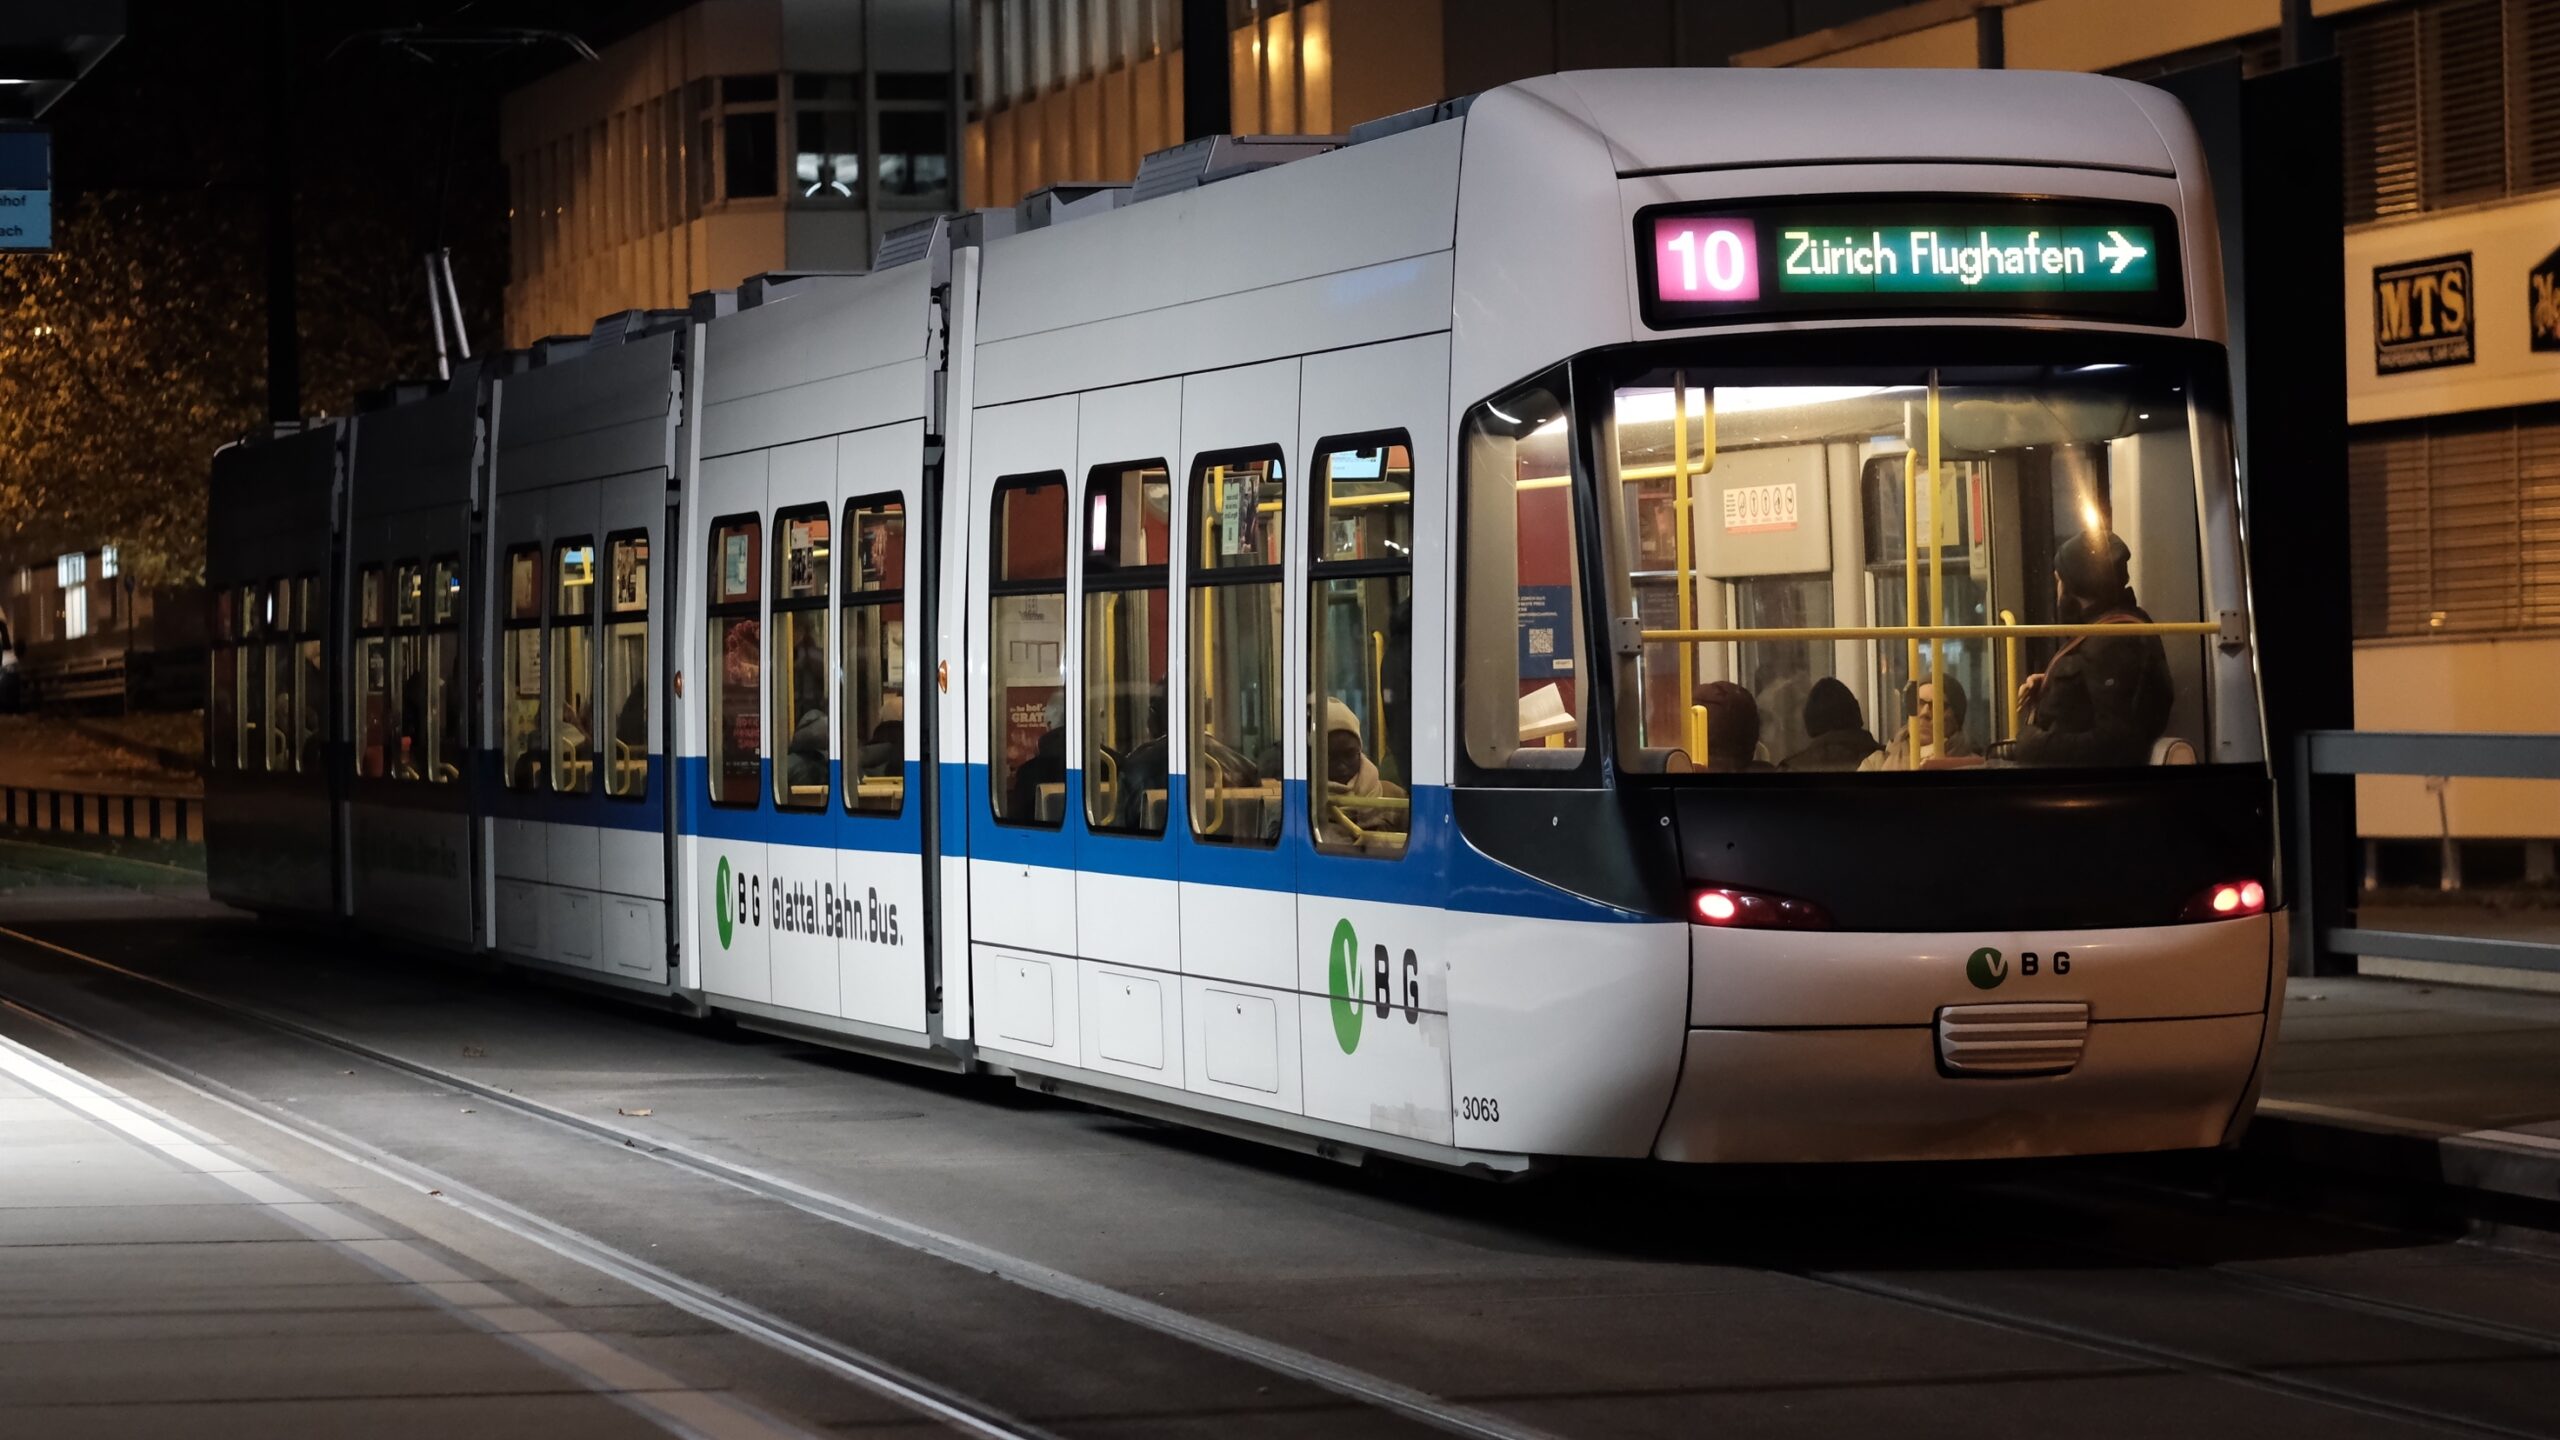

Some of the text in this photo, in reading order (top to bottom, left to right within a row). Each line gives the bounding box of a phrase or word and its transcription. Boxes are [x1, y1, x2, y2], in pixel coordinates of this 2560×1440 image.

[1667, 230, 2084, 291] 10 Zürich Flughafen
[2380, 270, 2465, 341] MTS
[1012, 712, 1044, 723] GRAT
[1463, 1096, 1500, 1123] 3063
